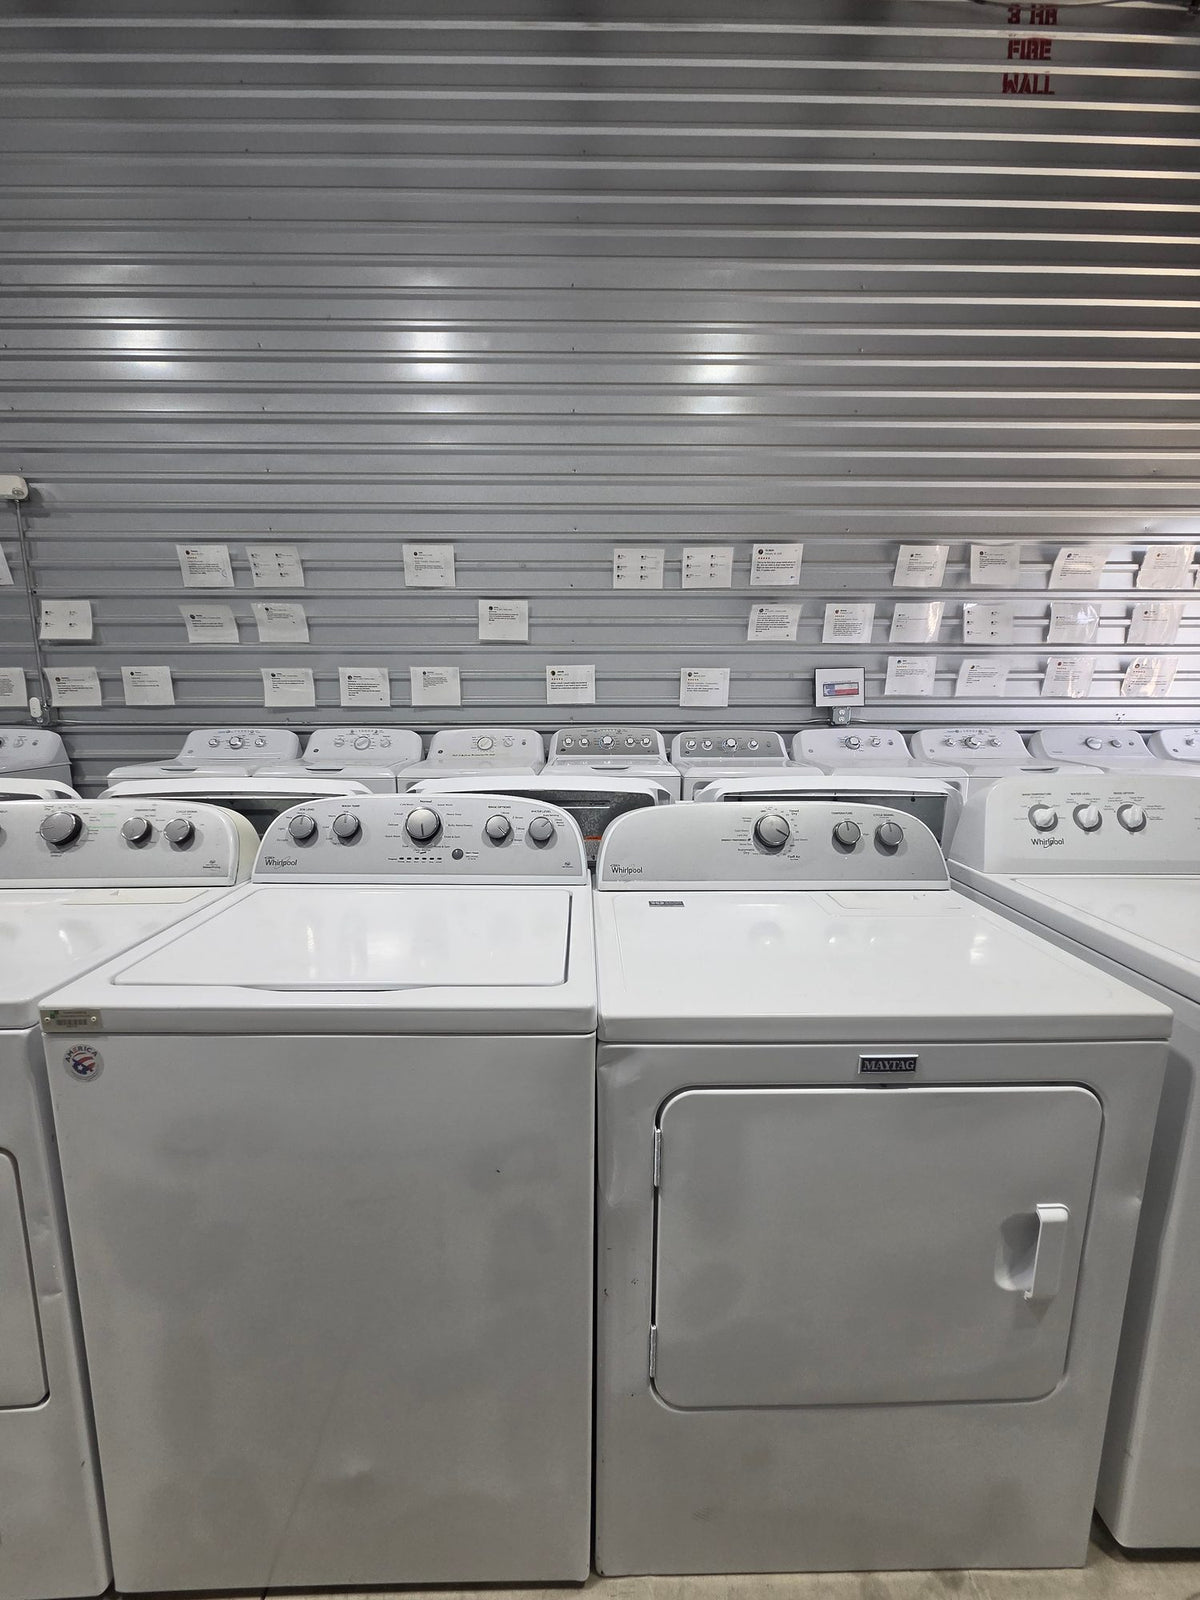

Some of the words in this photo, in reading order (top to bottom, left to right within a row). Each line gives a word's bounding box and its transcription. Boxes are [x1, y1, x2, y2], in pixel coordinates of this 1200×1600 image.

[1008, 4, 1020, 24] 3
[1007, 38, 1052, 60] FIRE
[1002, 72, 1055, 95] WALL
[1030, 838, 1065, 848] Whirlpool
[264, 859, 298, 868] Whirlpool
[611, 865, 643, 875] Whirlpool
[65, 1045, 98, 1064] AMERICA
[863, 1060, 915, 1071] MAYTAG
